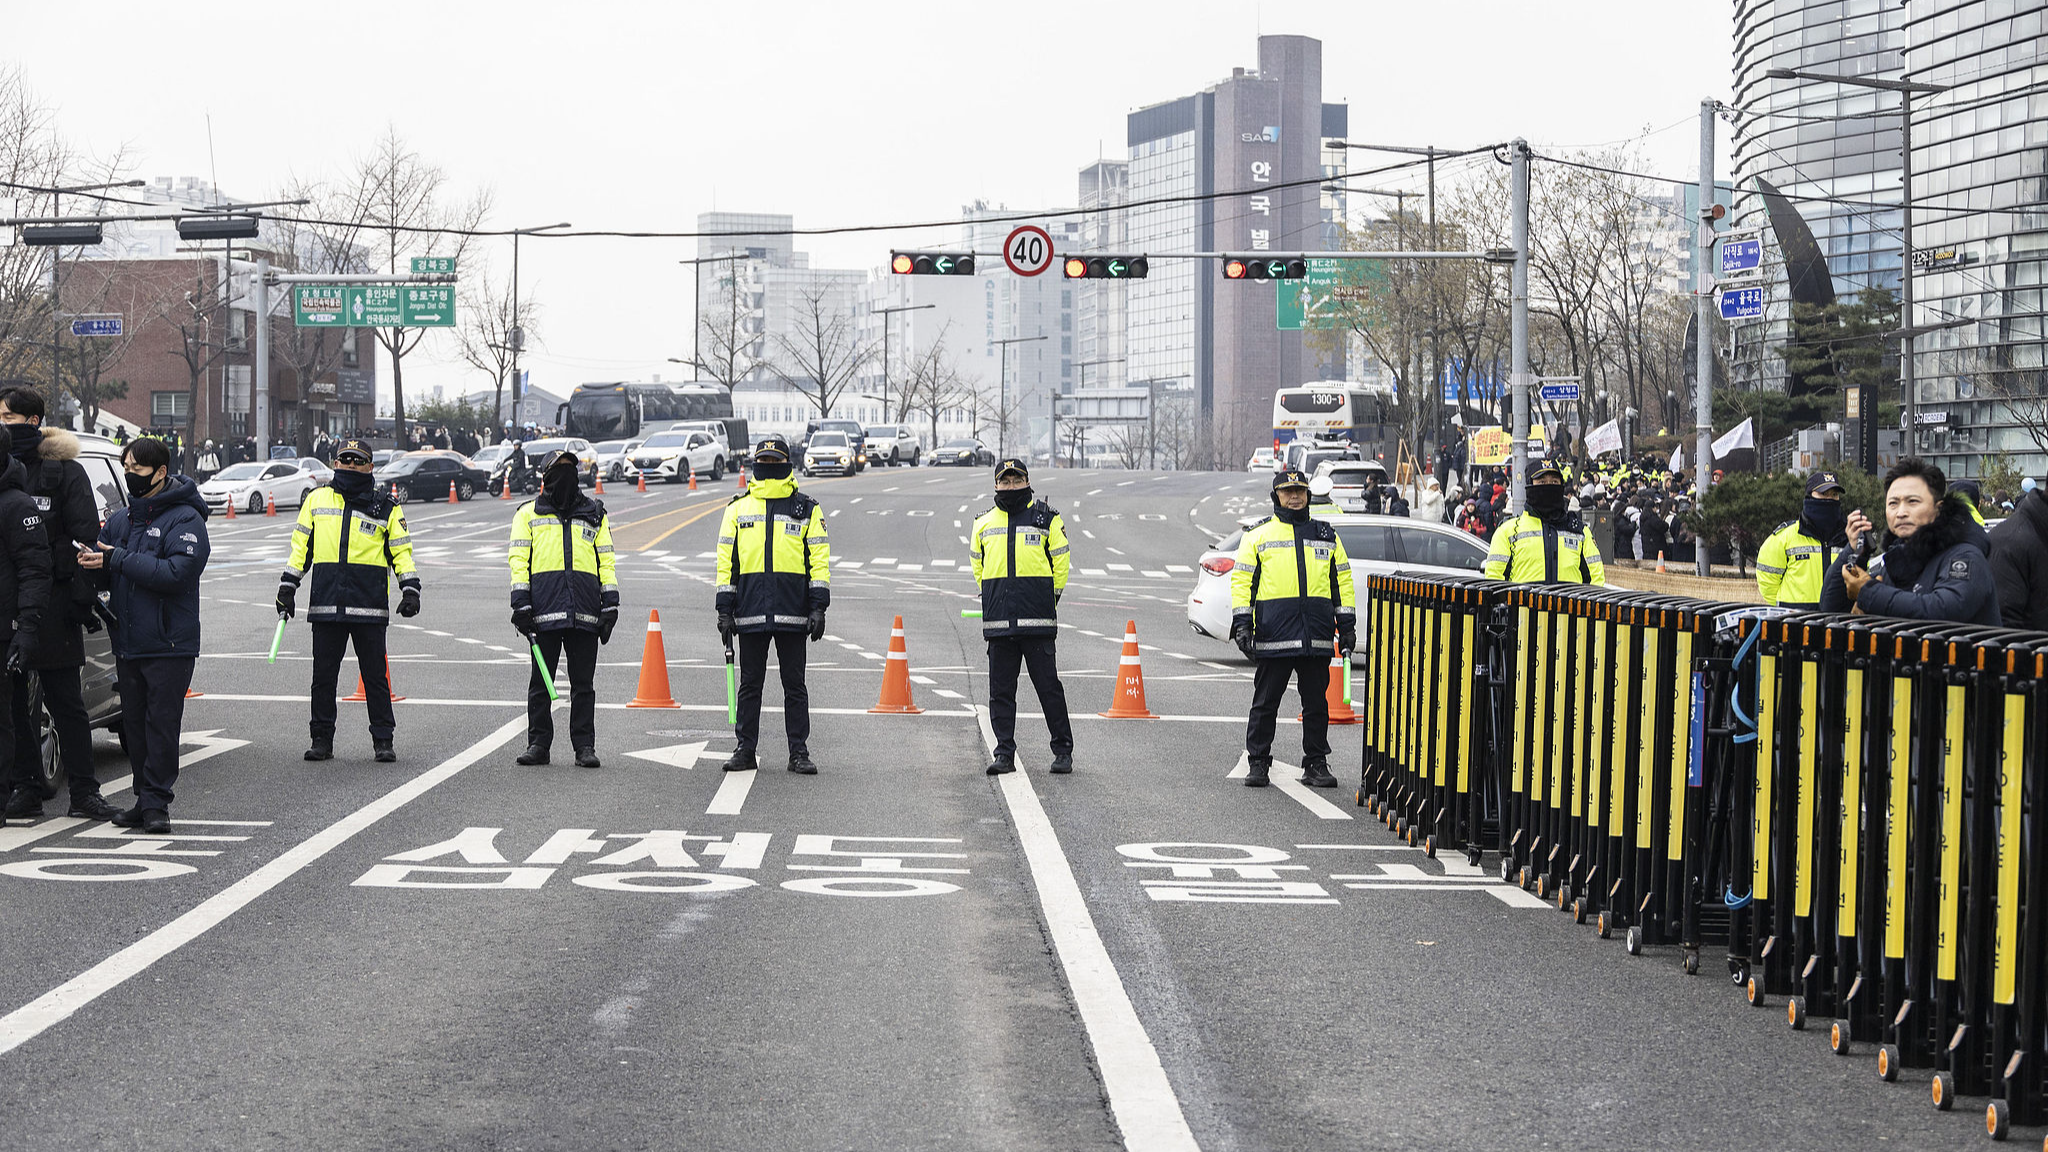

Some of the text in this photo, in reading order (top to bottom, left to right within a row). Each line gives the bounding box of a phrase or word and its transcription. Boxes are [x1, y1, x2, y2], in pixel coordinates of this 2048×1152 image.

[1250, 161, 1271, 284] 안국빌
[1013, 236, 1042, 264] 40
[1724, 245, 1743, 259] 사직로
[418, 260, 448, 271] 경복궁
[1724, 261, 1741, 270] Sajik-ro
[1311, 278, 1331, 286] Anguk
[366, 289, 397, 299] 흥인지문
[409, 290, 448, 301] 종로구청
[1739, 291, 1760, 305] 율곡로
[1736, 305, 1760, 316] Yulgok-ro
[350, 827, 970, 898] 삼청동
